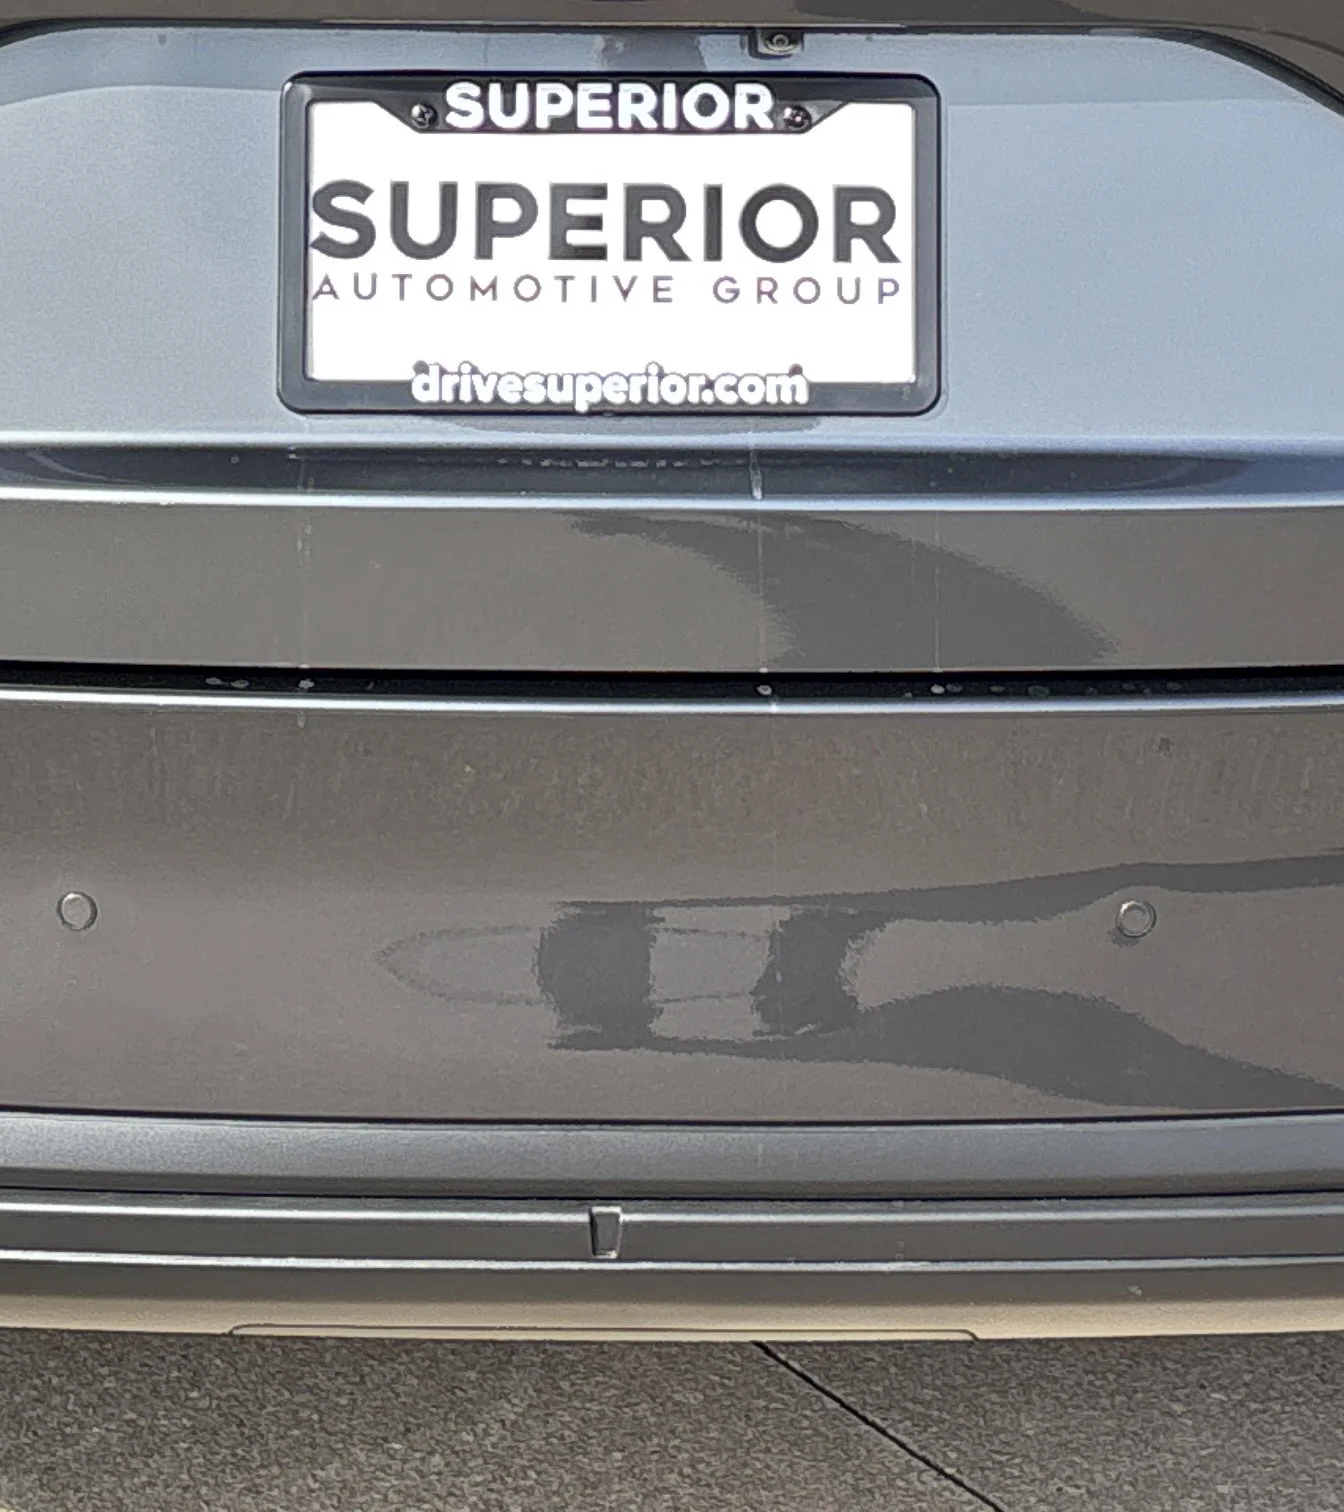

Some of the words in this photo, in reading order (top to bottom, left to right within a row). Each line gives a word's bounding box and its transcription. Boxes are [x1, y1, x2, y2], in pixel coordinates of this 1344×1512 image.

[445, 81, 775, 131] SUPERIOR
[310, 180, 902, 264] SUPERIOR
[311, 272, 674, 303] AUTOMOTIVE
[712, 275, 901, 305] GROUP
[411, 362, 810, 414] drivesuperior.com
